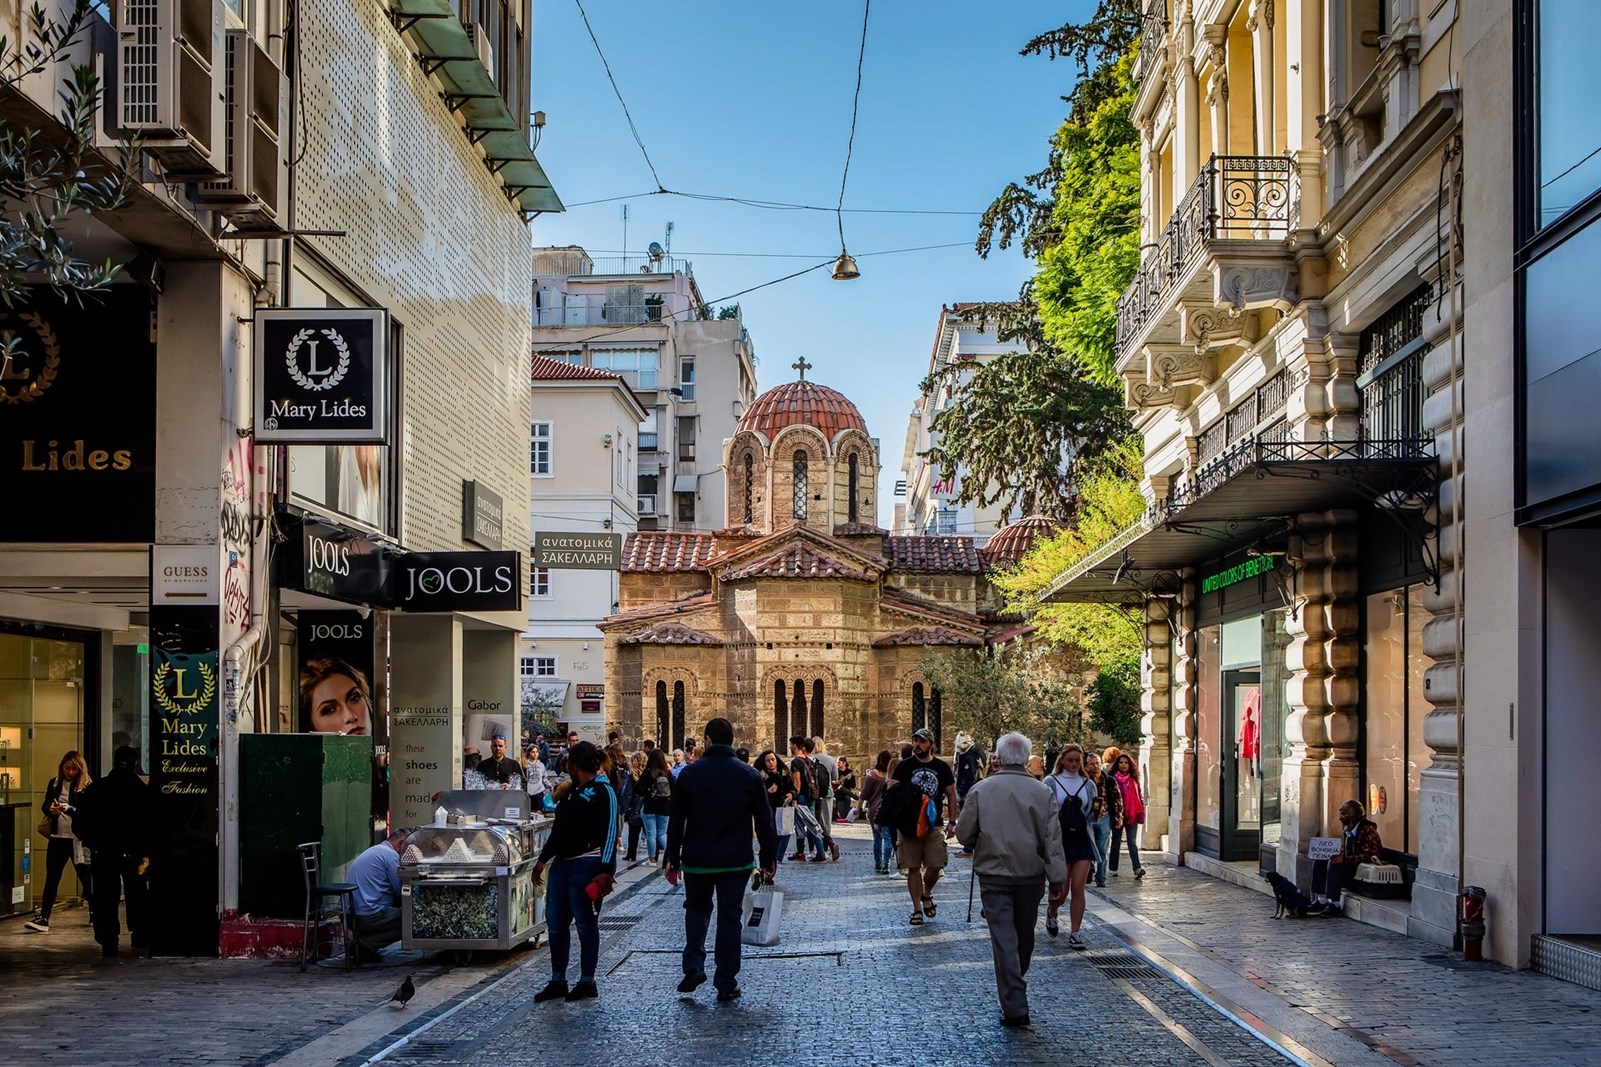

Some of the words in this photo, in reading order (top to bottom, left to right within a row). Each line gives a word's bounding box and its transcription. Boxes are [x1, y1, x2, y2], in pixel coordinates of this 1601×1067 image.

[307, 340, 332, 375] L
[270, 400, 317, 421] Mary
[321, 399, 366, 417] Lides
[22, 440, 131, 470] Lides
[932, 480, 954, 494] H&M
[542, 537, 613, 550] ανατομικά
[308, 535, 350, 577] JOOLS
[542, 552, 613, 564] ΣΑΚΕΛΛΑΡΗ
[163, 566, 208, 577] GUESS
[405, 566, 512, 601] JOOLS
[1203, 575, 1219, 594] UNITED
[1220, 567, 1237, 588] COLORS
[1238, 563, 1245, 580] OF
[310, 624, 363, 642] JOOLS
[173, 668, 198, 699] L
[393, 705, 449, 715] ανατομικά
[467, 699, 501, 711] Gabor
[393, 717, 449, 727] ΣΑΚΕΛΛΑΡΗ
[161, 719, 208, 740] Mary
[161, 740, 207, 755] Lides
[405, 744, 425, 753] these
[161, 759, 208, 773] Exclusive
[405, 760, 438, 770] shoes
[405, 776, 421, 785] are
[161, 781, 208, 794] Fashion
[405, 793, 431, 803] mad
[405, 810, 417, 818] for
